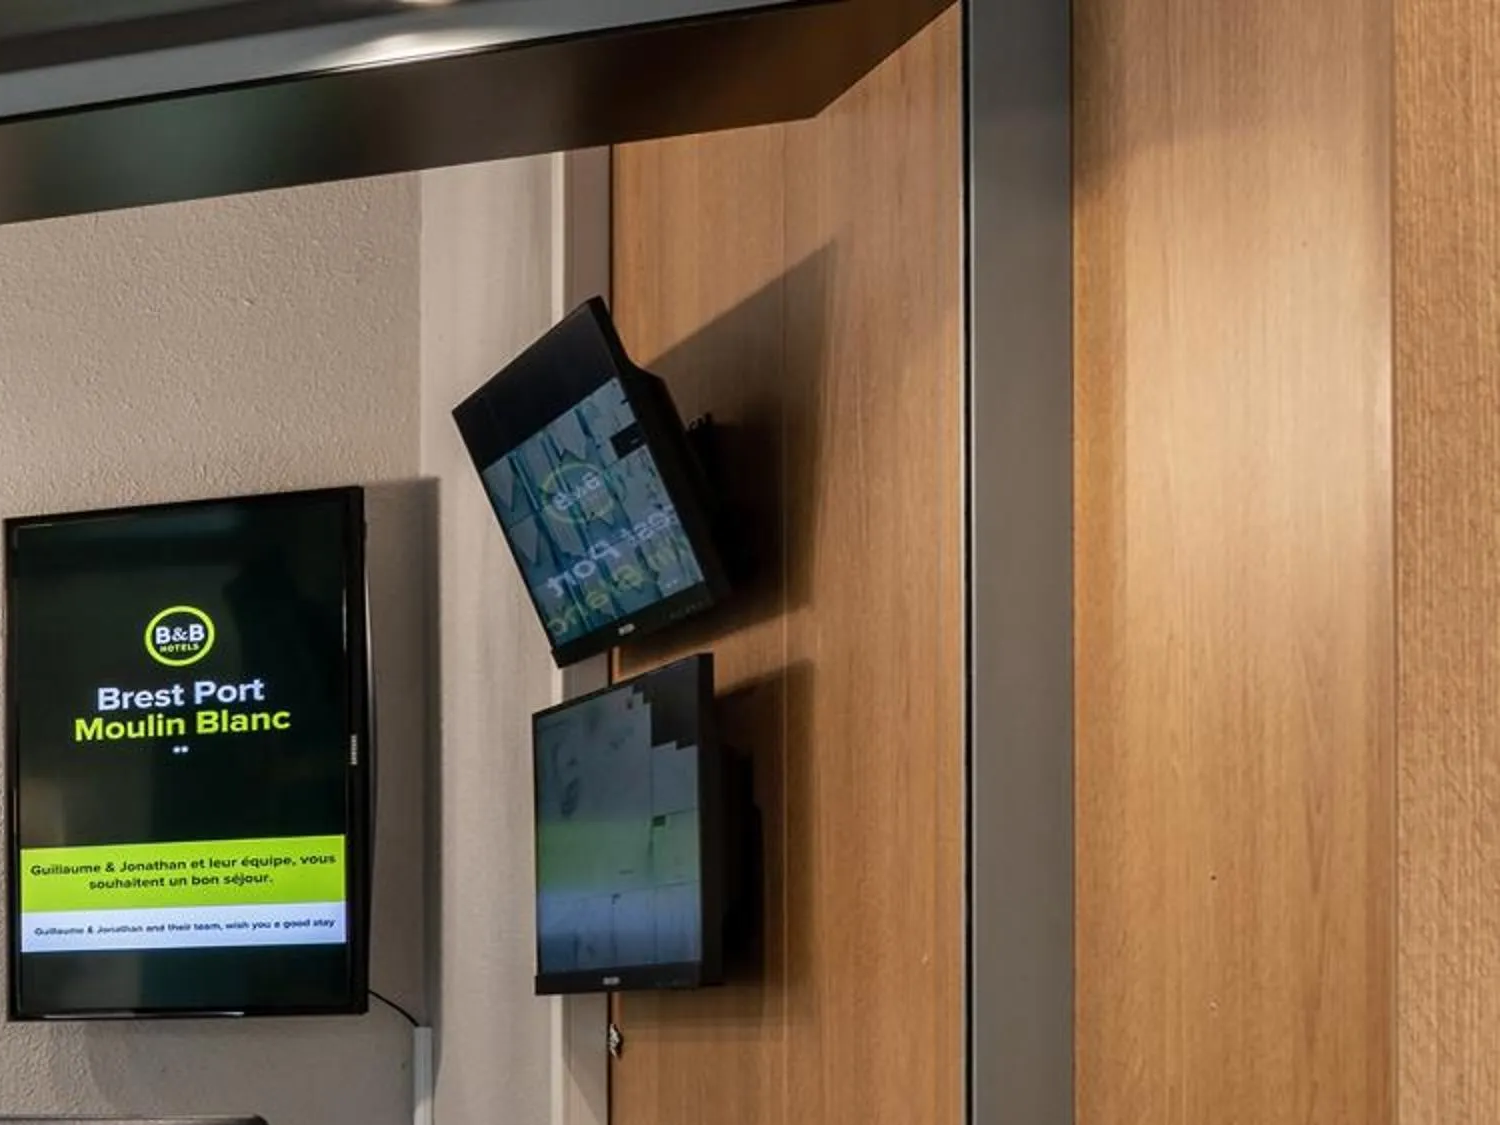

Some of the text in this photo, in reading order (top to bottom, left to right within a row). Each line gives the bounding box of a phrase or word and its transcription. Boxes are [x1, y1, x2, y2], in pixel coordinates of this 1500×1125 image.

[155, 623, 205, 645] B&B
[159, 643, 200, 653] HOTELS
[97, 678, 265, 711] Brest Port
[74, 709, 292, 742] Moulin Blanc
[30, 854, 336, 876] Guillaume & Jonathan et leur équipe, vous
[89, 872, 274, 890] souhaitent un bon séjour.
[34, 926, 85, 937] Guillaume
[87, 925, 94, 934] &
[97, 924, 144, 934] Jonathan
[145, 924, 165, 932] and
[167, 923, 192, 932] their
[225, 921, 250, 930] wish
[251, 921, 272, 931] you
[284, 919, 311, 930] good
[313, 918, 336, 929] stay
